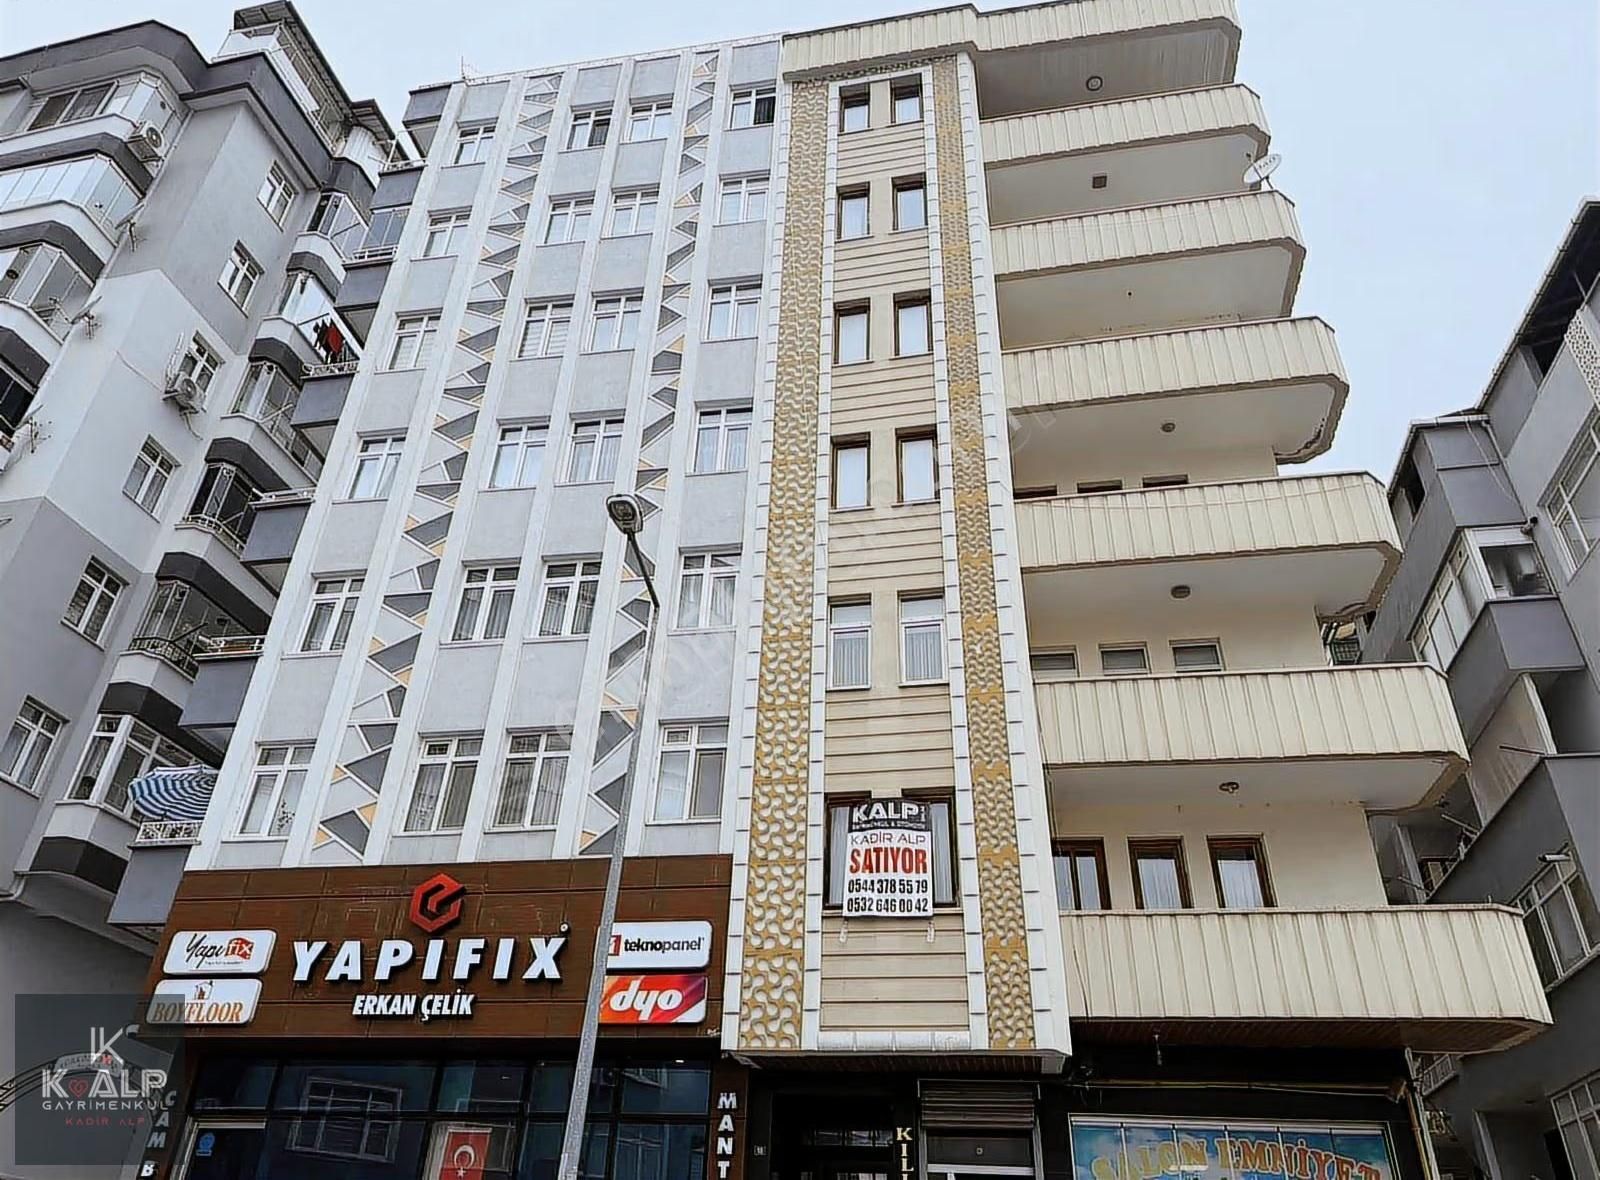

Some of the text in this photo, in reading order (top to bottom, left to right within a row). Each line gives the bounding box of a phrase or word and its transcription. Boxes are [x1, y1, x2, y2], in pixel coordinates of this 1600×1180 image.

[852, 802, 919, 823] KALP
[897, 833, 926, 845] ALP
[849, 846, 928, 874] SATIYOR
[848, 879, 928, 894] 0544 378 55 79
[847, 897, 928, 913] 0532 646 00 42
[624, 937, 702, 954] teknopanel
[293, 936, 567, 981] YAPIFIX
[352, 988, 475, 1021] ERKAN ÇELİK
[609, 979, 683, 1021] dyo
[152, 1001, 244, 1023] BOYFLOOR
